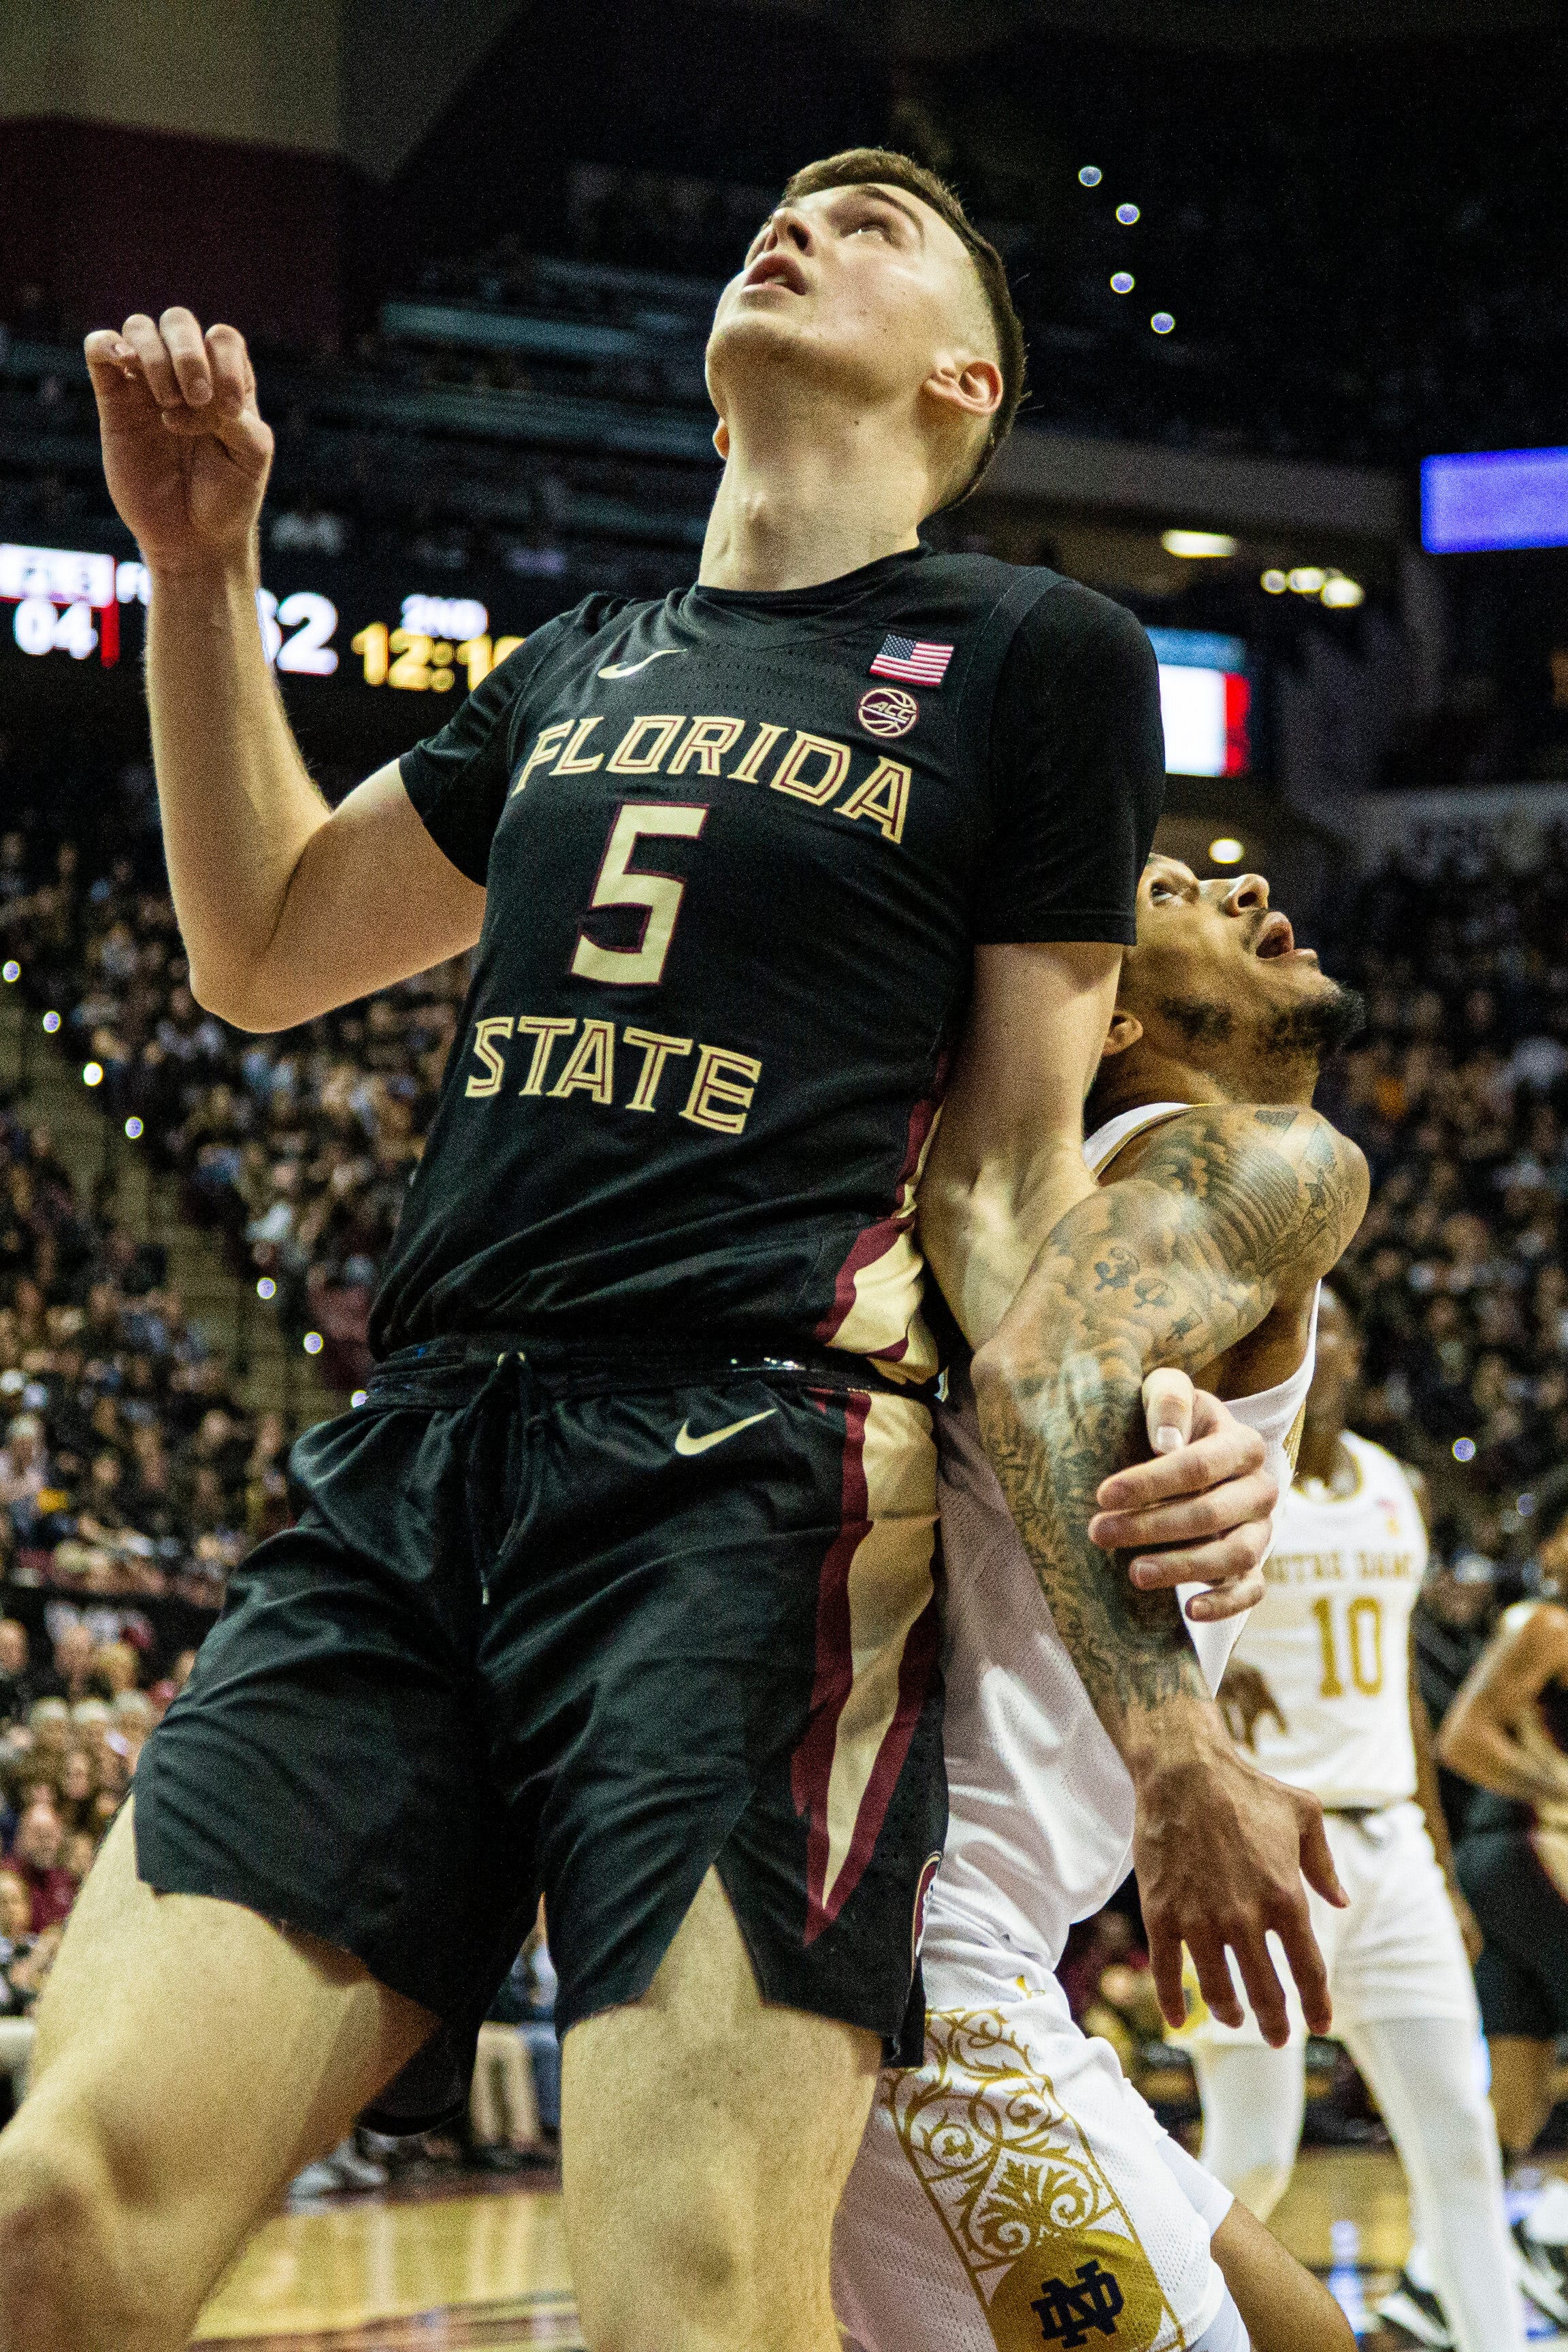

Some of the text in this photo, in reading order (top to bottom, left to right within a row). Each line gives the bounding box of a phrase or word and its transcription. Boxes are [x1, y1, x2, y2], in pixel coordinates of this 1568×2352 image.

[14, 598, 98, 659] 04
[866, 701, 917, 721] ACC
[510, 715, 913, 845] FLORIDA
[569, 800, 710, 987] 5
[465, 1015, 763, 1135] STATE
[1311, 1595, 1384, 1698] 10
